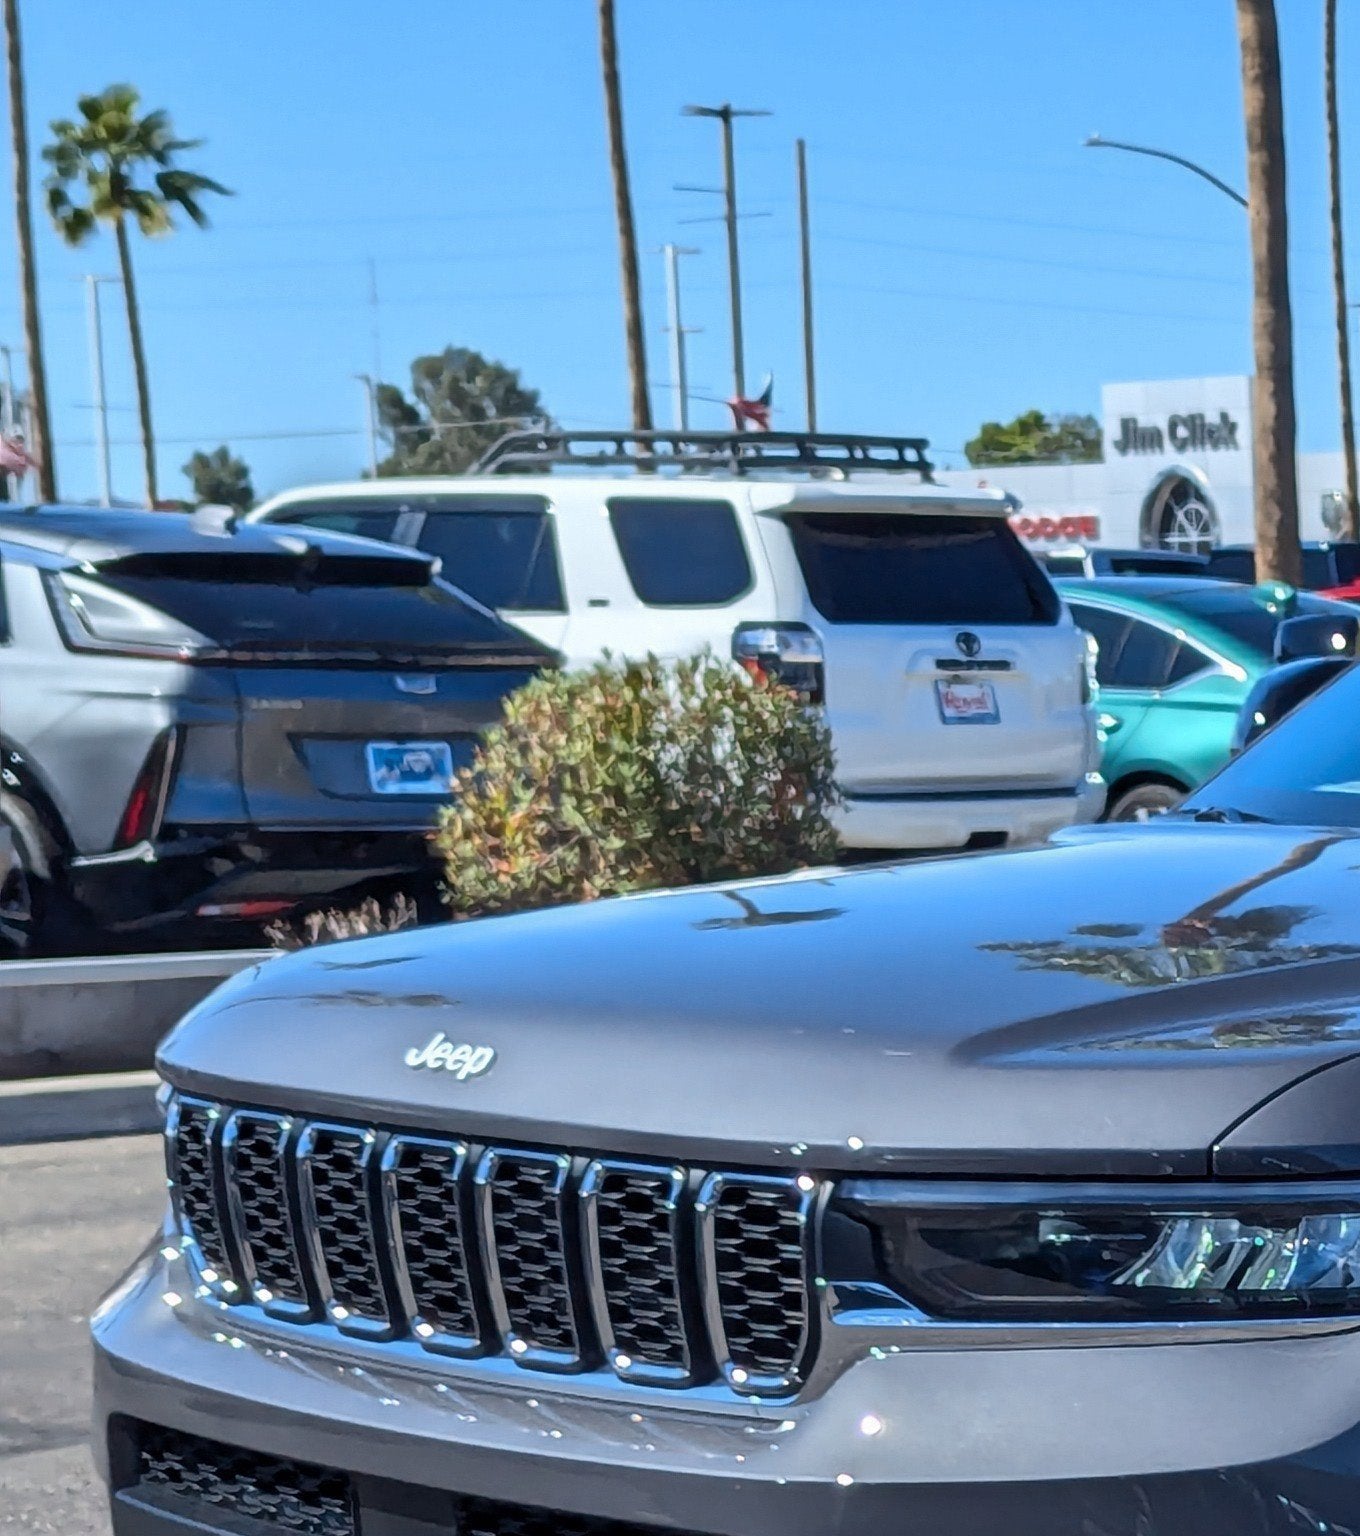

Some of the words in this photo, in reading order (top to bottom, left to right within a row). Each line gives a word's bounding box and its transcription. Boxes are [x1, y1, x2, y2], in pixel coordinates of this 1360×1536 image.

[1113, 417, 1163, 456] Jim
[1168, 411, 1239, 452] Click
[404, 1032, 497, 1081] Jeep
